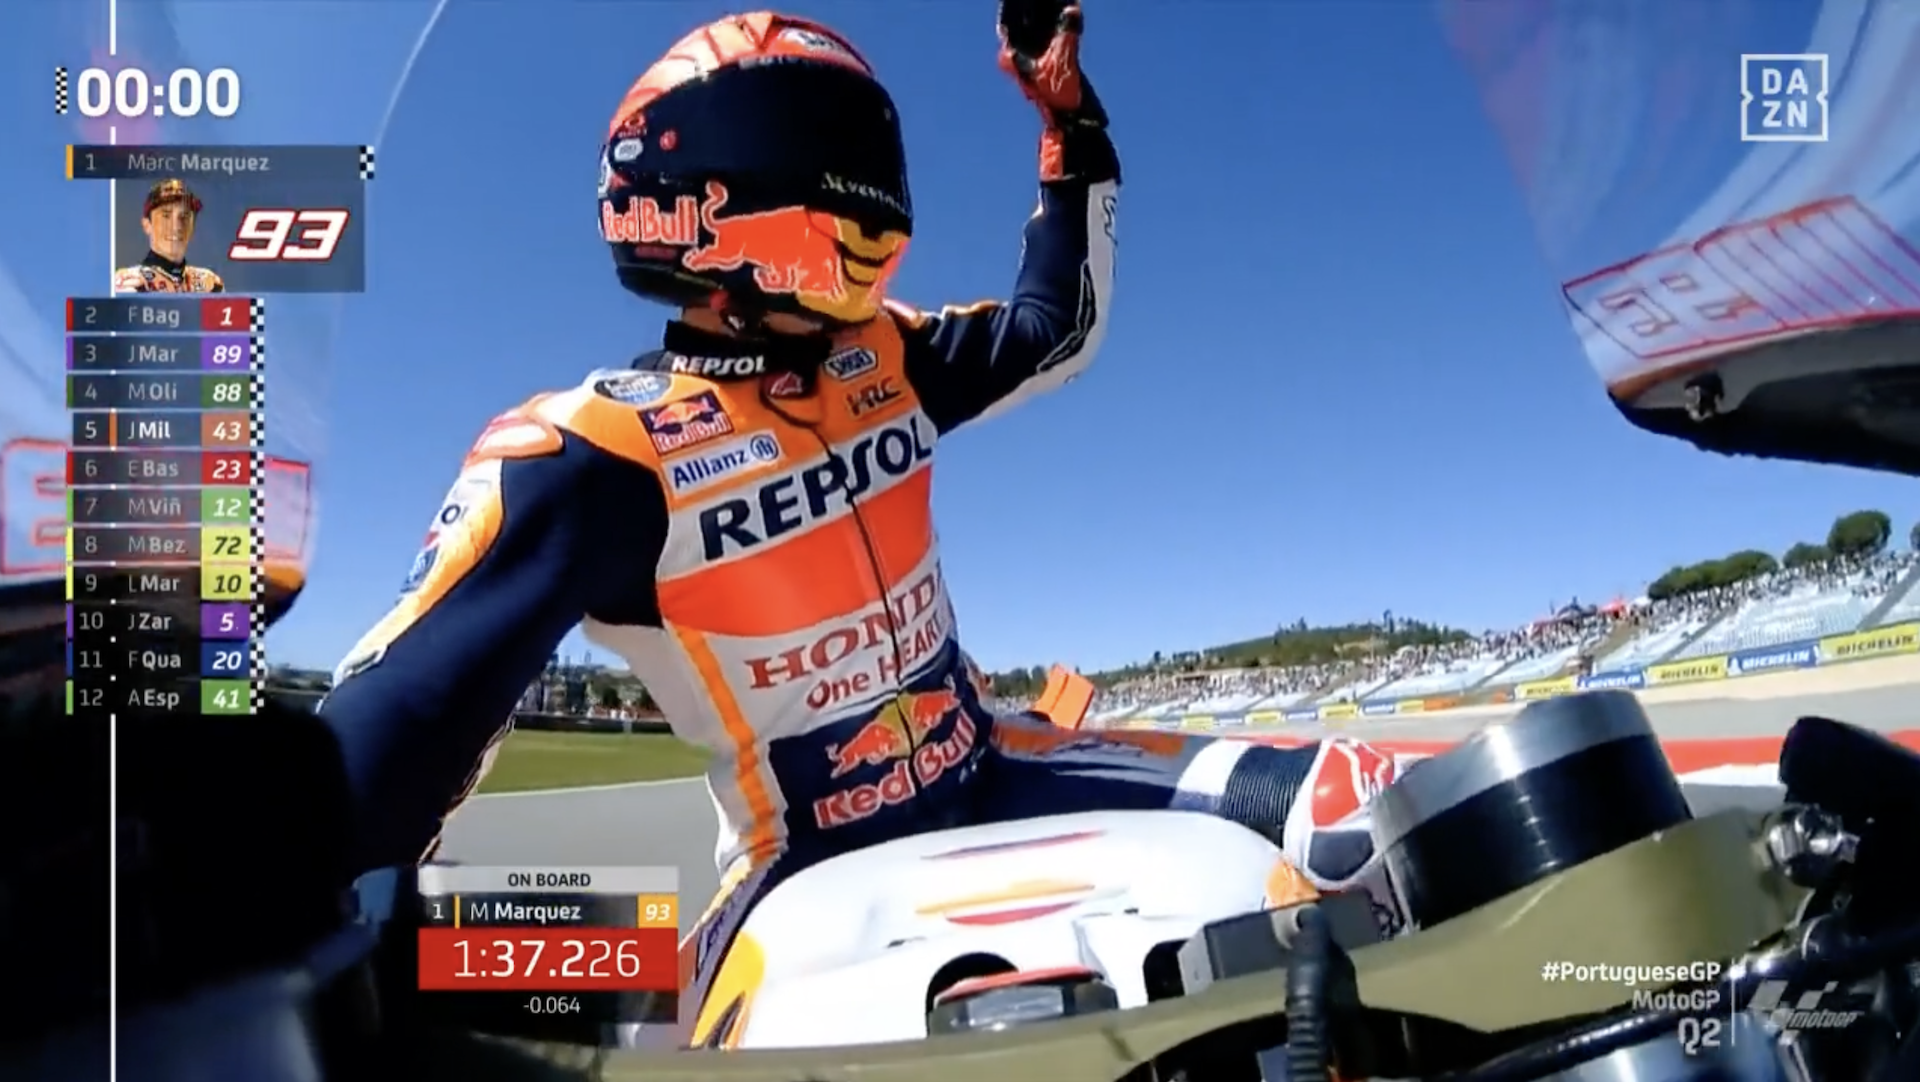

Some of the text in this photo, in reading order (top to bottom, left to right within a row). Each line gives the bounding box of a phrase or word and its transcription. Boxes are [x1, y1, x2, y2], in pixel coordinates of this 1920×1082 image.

[603, 196, 698, 244] Red Bull
[672, 355, 765, 375] REPSOL
[846, 377, 902, 415] HRC
[697, 411, 731, 440] Bull
[673, 449, 749, 489] Allianz
[700, 415, 932, 562] REPSOL
[745, 573, 935, 689] HOND
[806, 613, 941, 709] One HEART
[813, 761, 916, 829] Red
[913, 709, 977, 788] Bull
